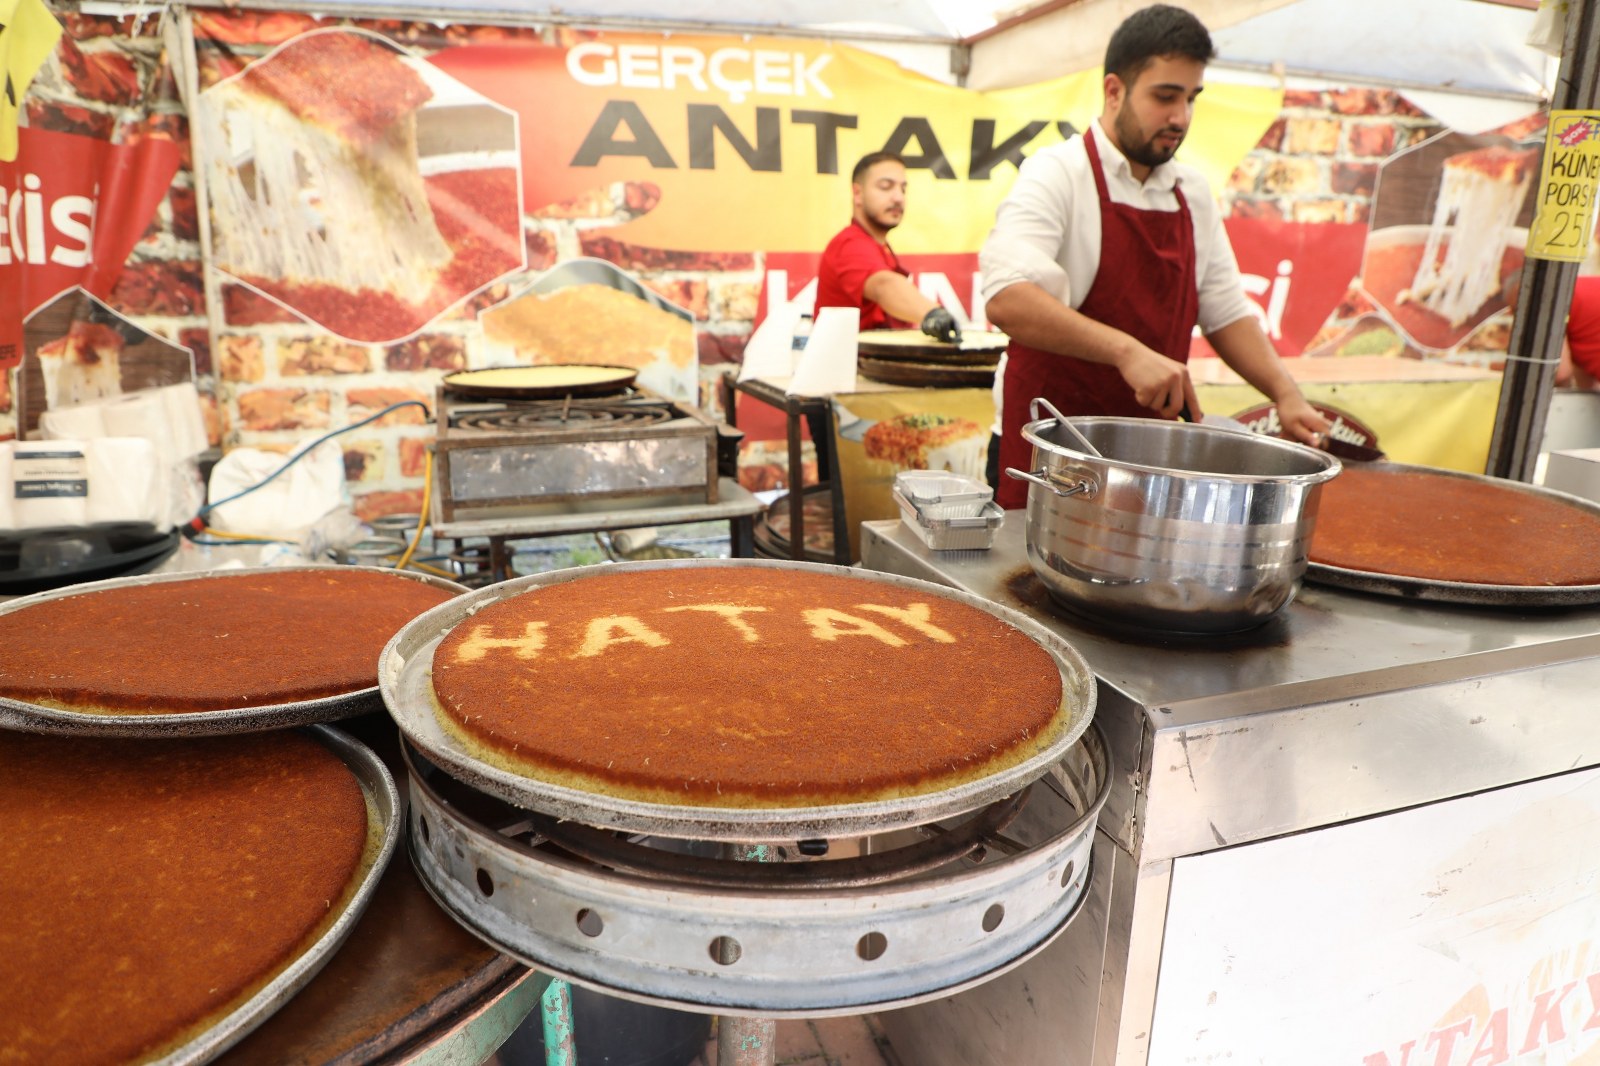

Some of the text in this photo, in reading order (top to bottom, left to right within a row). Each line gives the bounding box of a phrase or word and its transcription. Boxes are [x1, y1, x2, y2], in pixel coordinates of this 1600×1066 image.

[565, 42, 835, 104] GERÇEK
[569, 99, 1082, 180] ANTAK
[1551, 148, 1600, 179] KÜNE
[452, 602, 957, 664] HATAY
